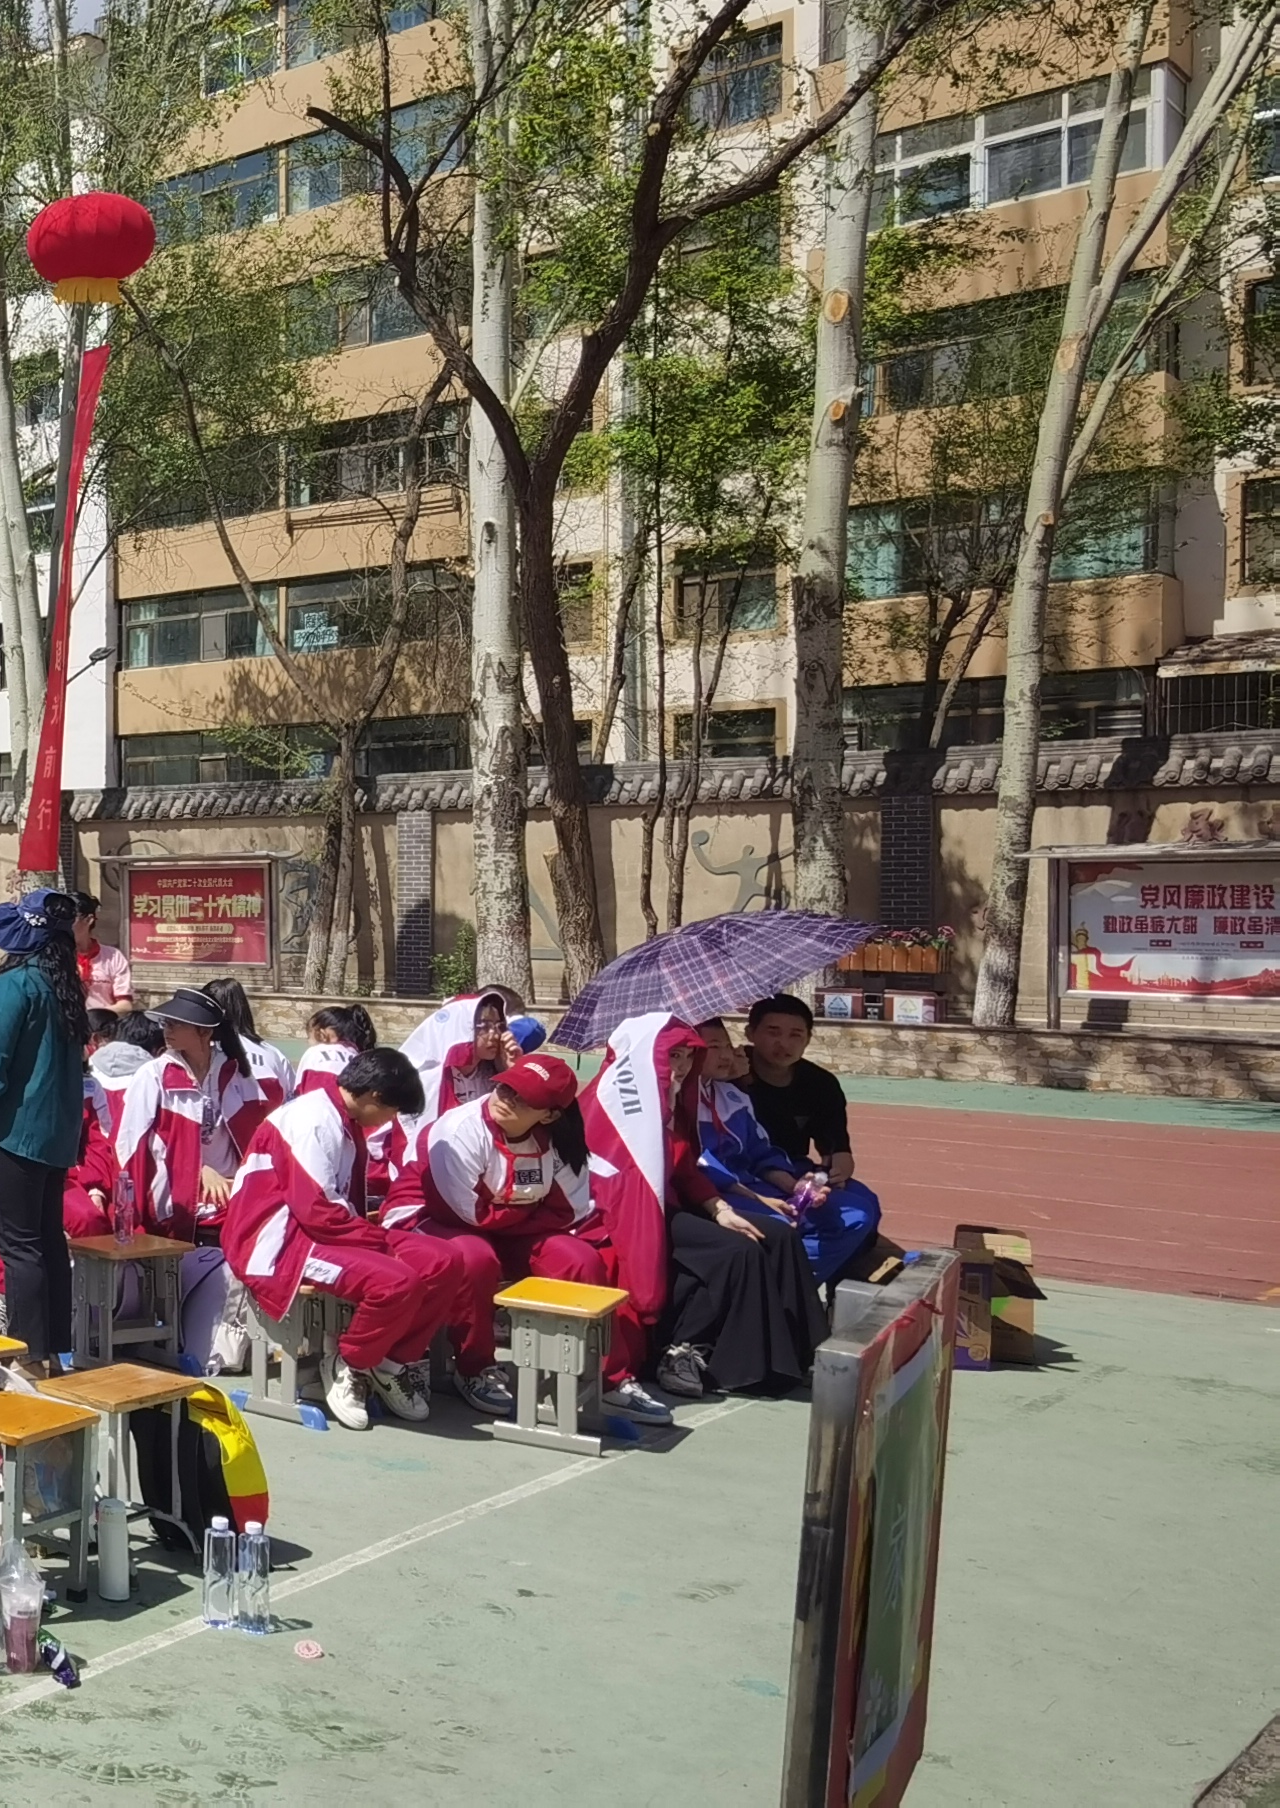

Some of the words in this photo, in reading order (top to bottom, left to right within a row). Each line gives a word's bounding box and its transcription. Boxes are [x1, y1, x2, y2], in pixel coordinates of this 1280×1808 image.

[133, 893, 263, 920] 学习贯彻二十大精神
[1140, 884, 1276, 910] 党风廉政建设
